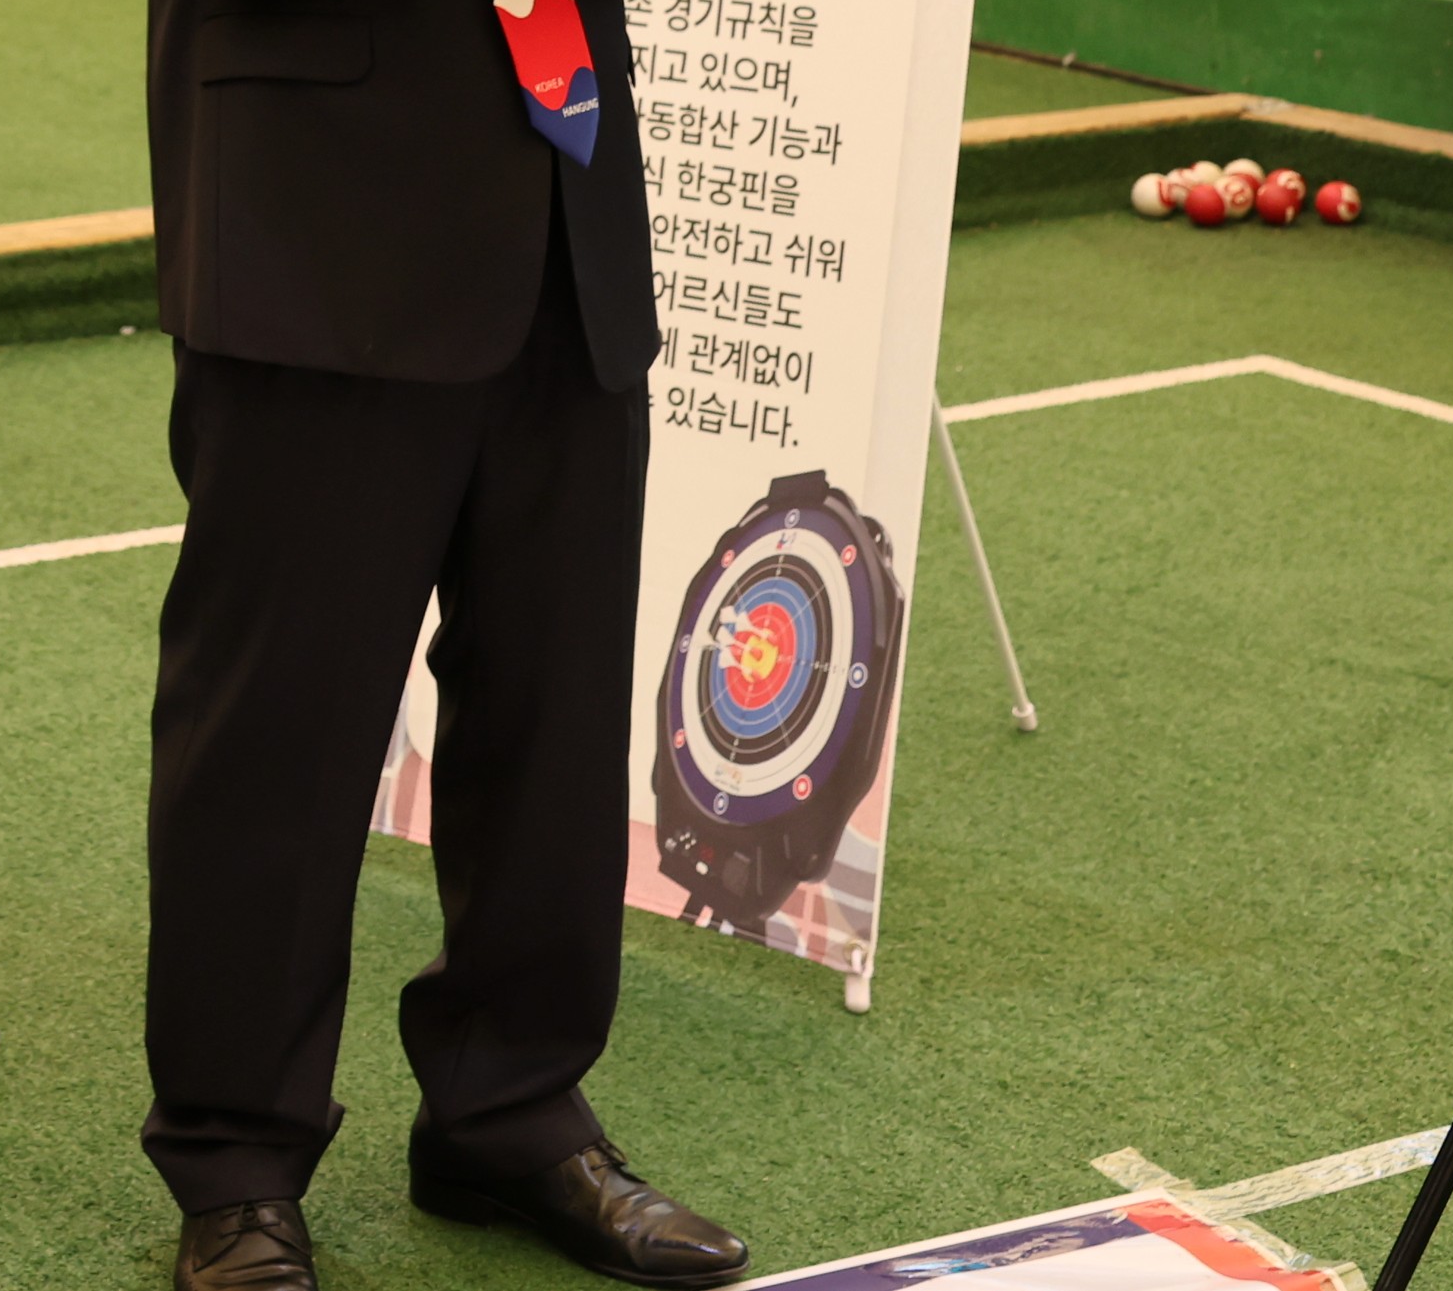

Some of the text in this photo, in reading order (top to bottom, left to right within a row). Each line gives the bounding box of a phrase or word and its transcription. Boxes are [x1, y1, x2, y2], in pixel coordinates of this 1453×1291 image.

[535, 76, 565, 93] KOREA
[631, 44, 798, 109] 지고 있으며,
[637, 97, 843, 167] 동합산 기능과
[644, 156, 800, 217] 식 한궁핀을
[651, 213, 846, 284] 안전하고 쉬워
[653, 270, 803, 330] 어르신들도
[688, 333, 814, 395] 관계없이
[666, 386, 798, 449] 있습니다.
